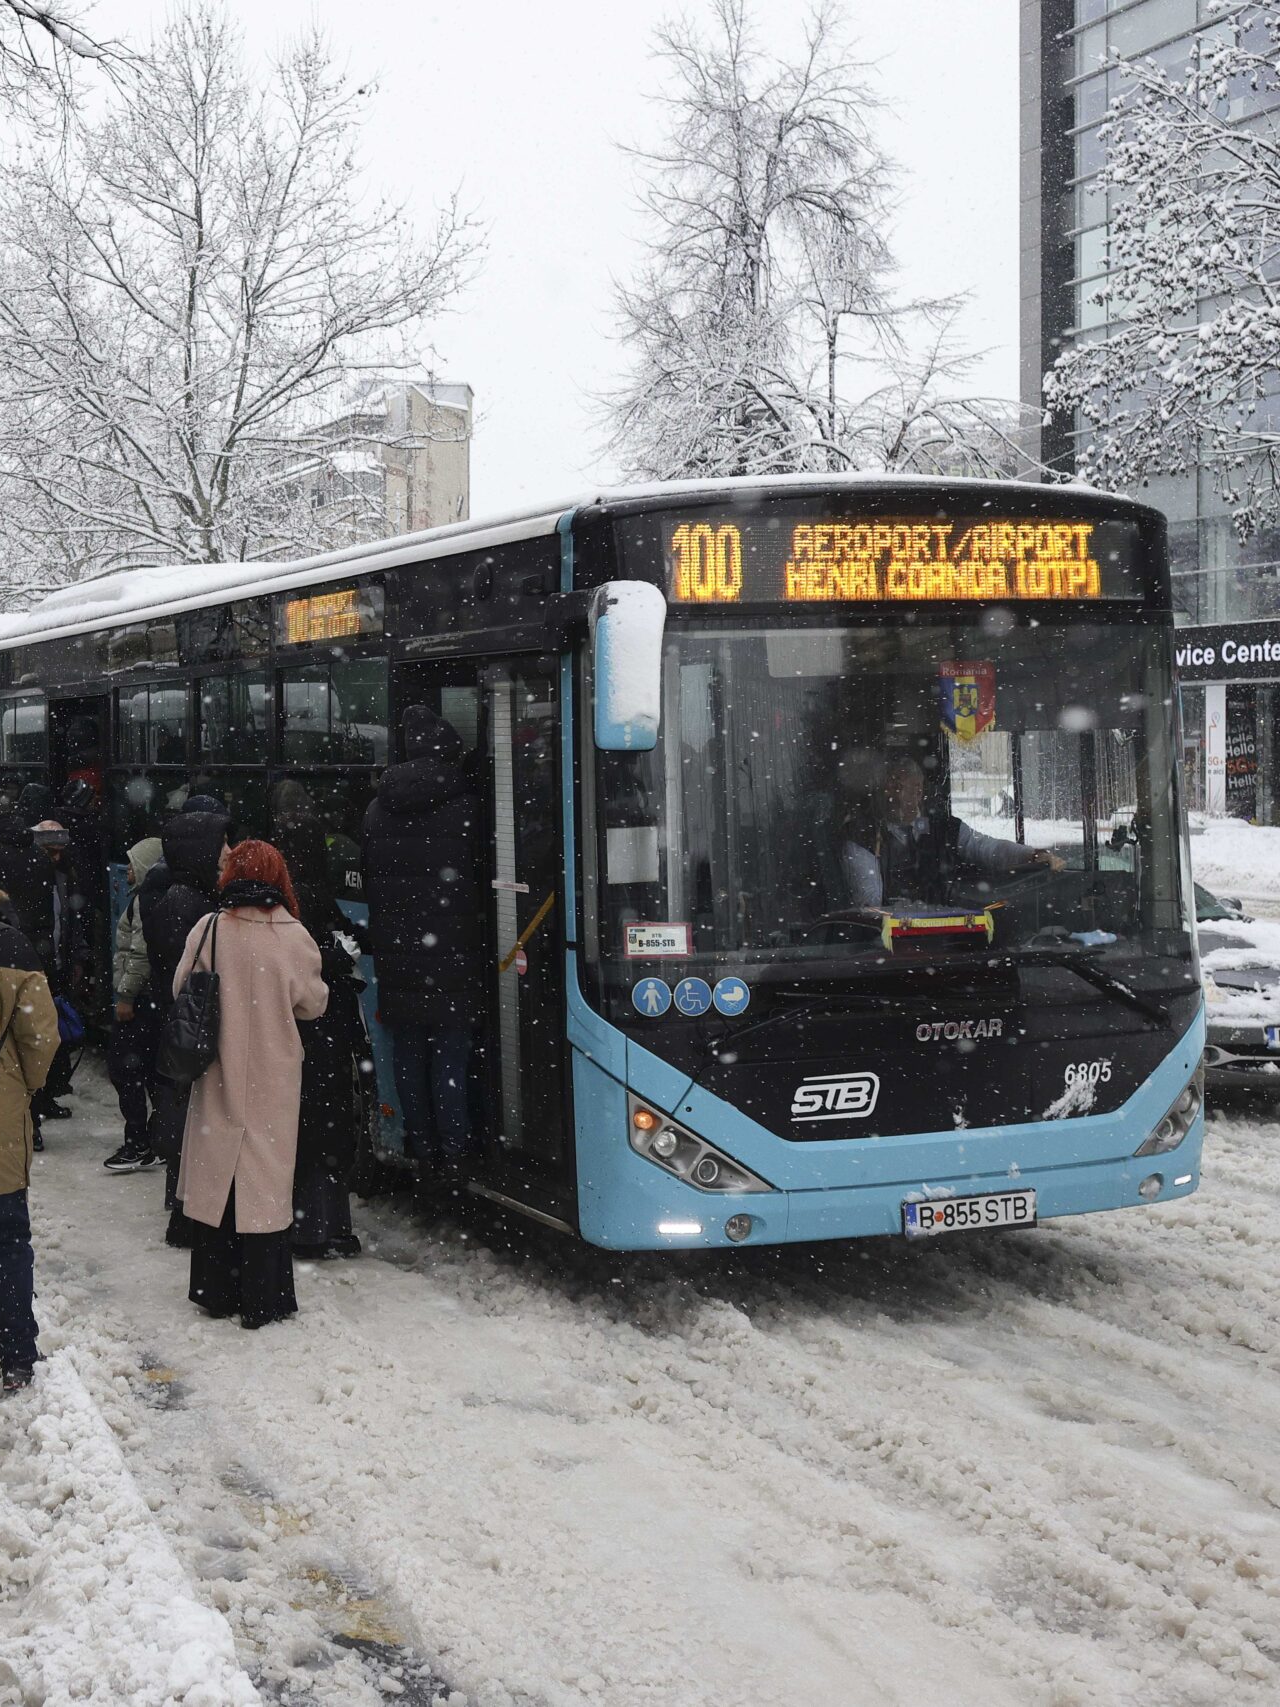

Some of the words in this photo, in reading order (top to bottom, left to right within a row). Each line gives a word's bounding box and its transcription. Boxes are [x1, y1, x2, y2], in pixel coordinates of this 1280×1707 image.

[672, 524, 741, 600] 100
[793, 524, 1093, 560] AEROPORT/AIRPORT
[785, 561, 876, 599] HENRI
[886, 561, 1007, 598] COANDA
[1176, 643, 1215, 666] vice
[639, 939, 676, 948] B-855-STB
[916, 1018, 1003, 1042] OTOKAR
[1064, 1061, 1112, 1086] 6805
[791, 1079, 872, 1114] STB
[985, 1196, 1027, 1223] STB
